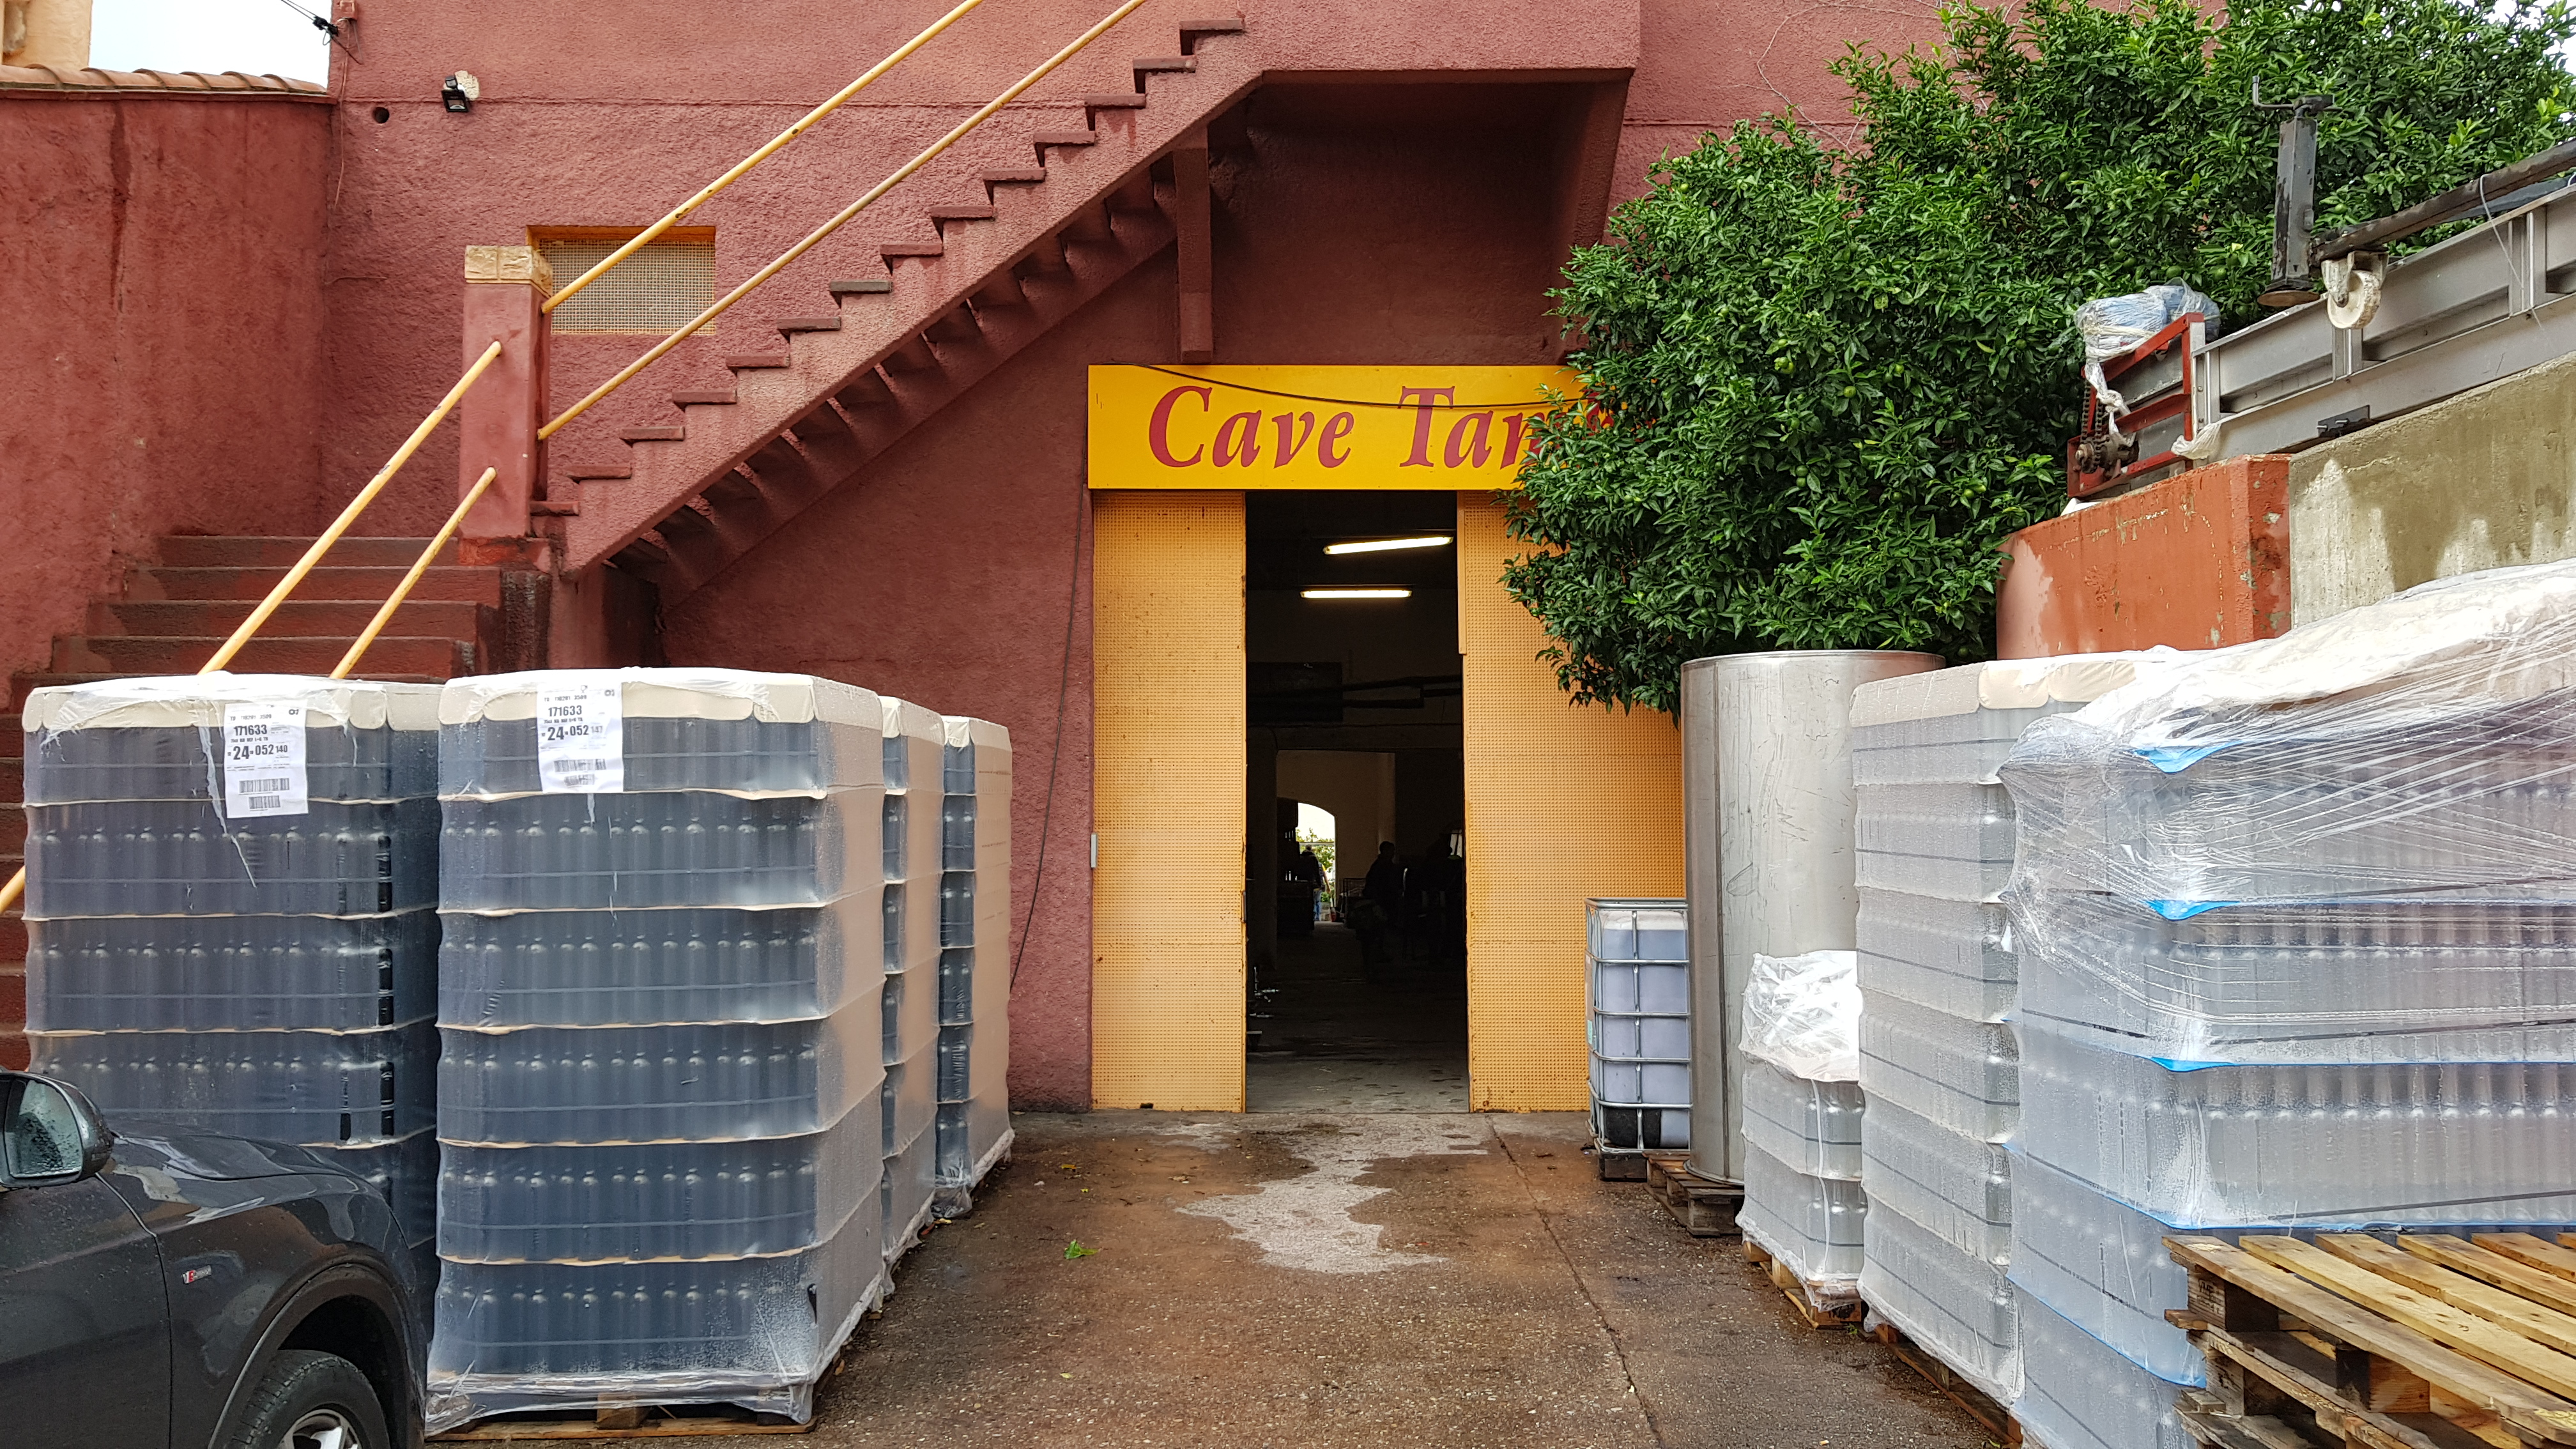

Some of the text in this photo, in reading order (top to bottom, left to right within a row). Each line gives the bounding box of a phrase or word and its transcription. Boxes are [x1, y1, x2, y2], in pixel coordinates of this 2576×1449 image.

[1149, 385, 1616, 471] Cave Tan
[548, 705, 582, 717] 171633
[233, 724, 268, 736] 171633
[548, 726, 564, 740] 24
[570, 724, 588, 736] 052
[233, 746, 250, 760] 24
[255, 744, 274, 756] 052
[275, 744, 288, 753] 140
